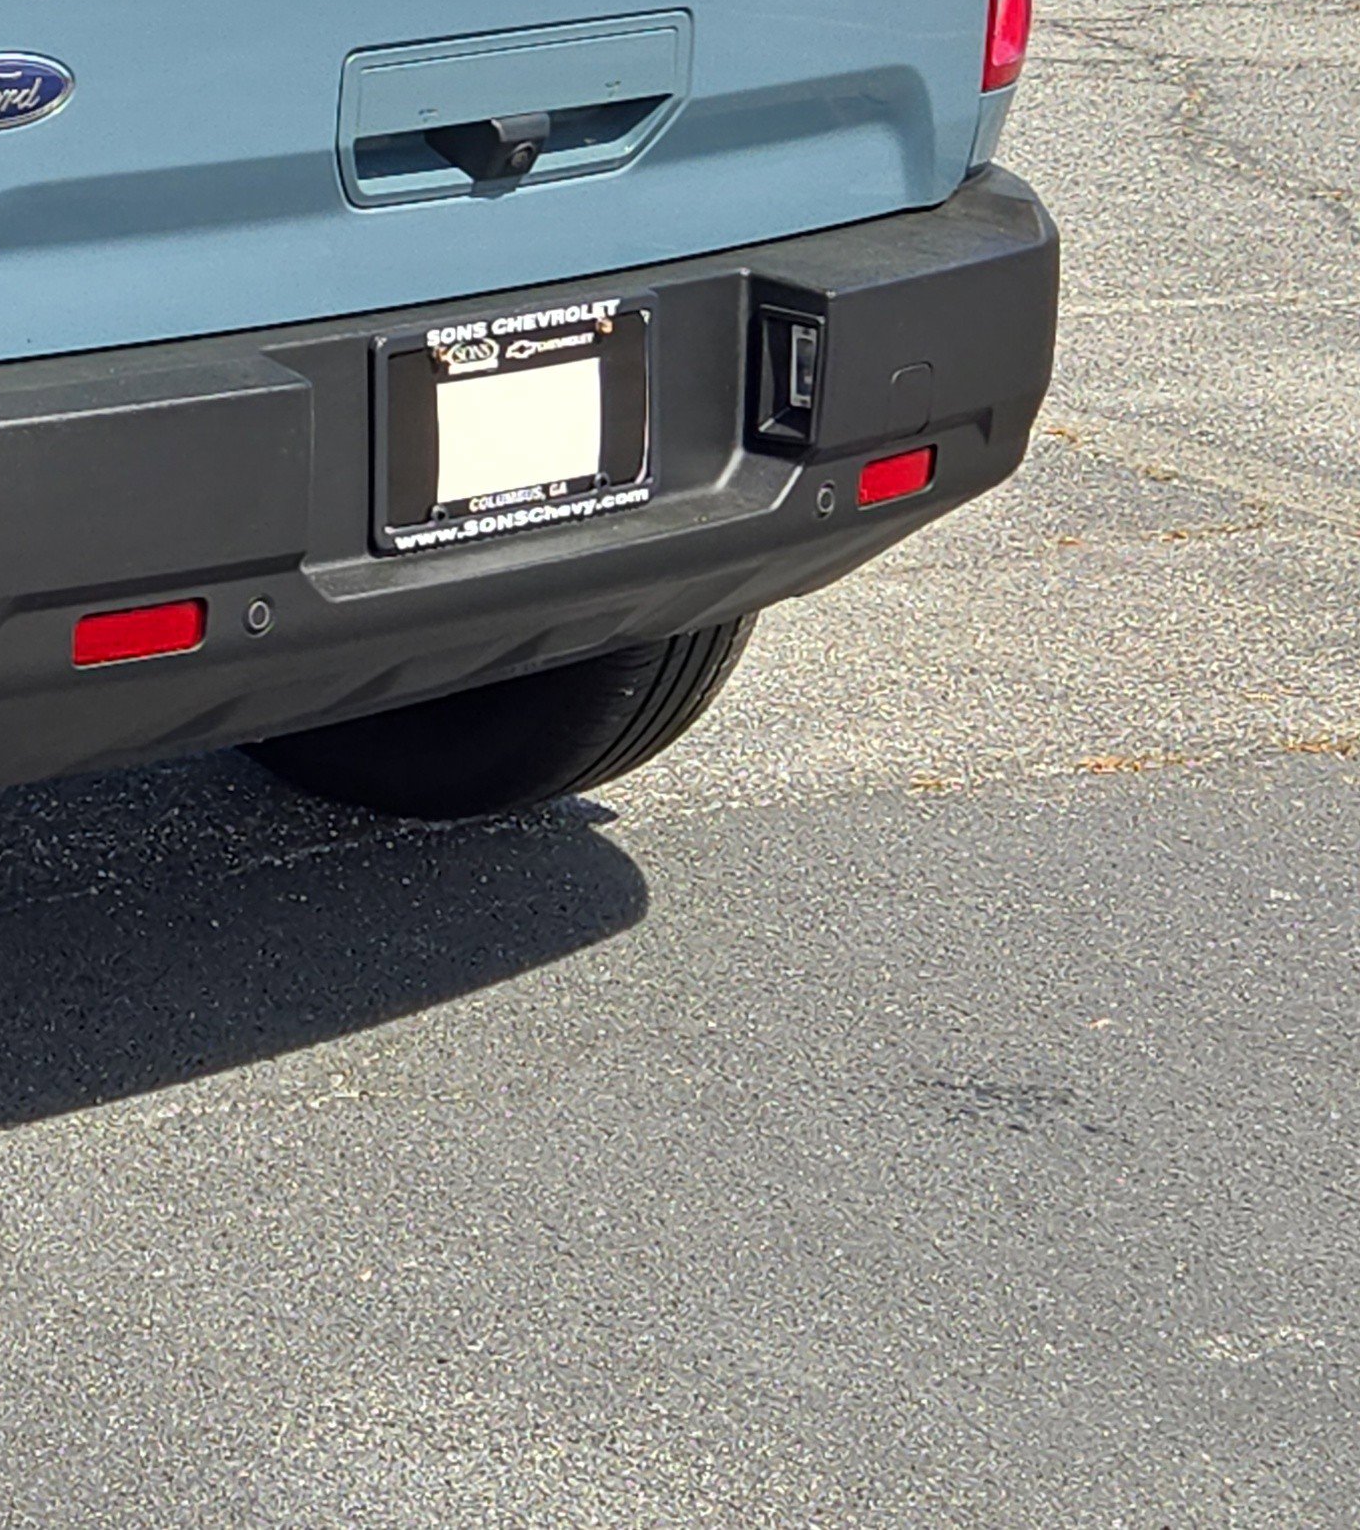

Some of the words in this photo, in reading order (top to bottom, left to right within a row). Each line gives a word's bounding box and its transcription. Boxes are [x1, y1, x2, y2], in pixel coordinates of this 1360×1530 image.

[427, 321, 488, 347] SONS
[491, 298, 621, 337] CHEVROLET
[394, 487, 650, 551] www.SONSChevy.com
